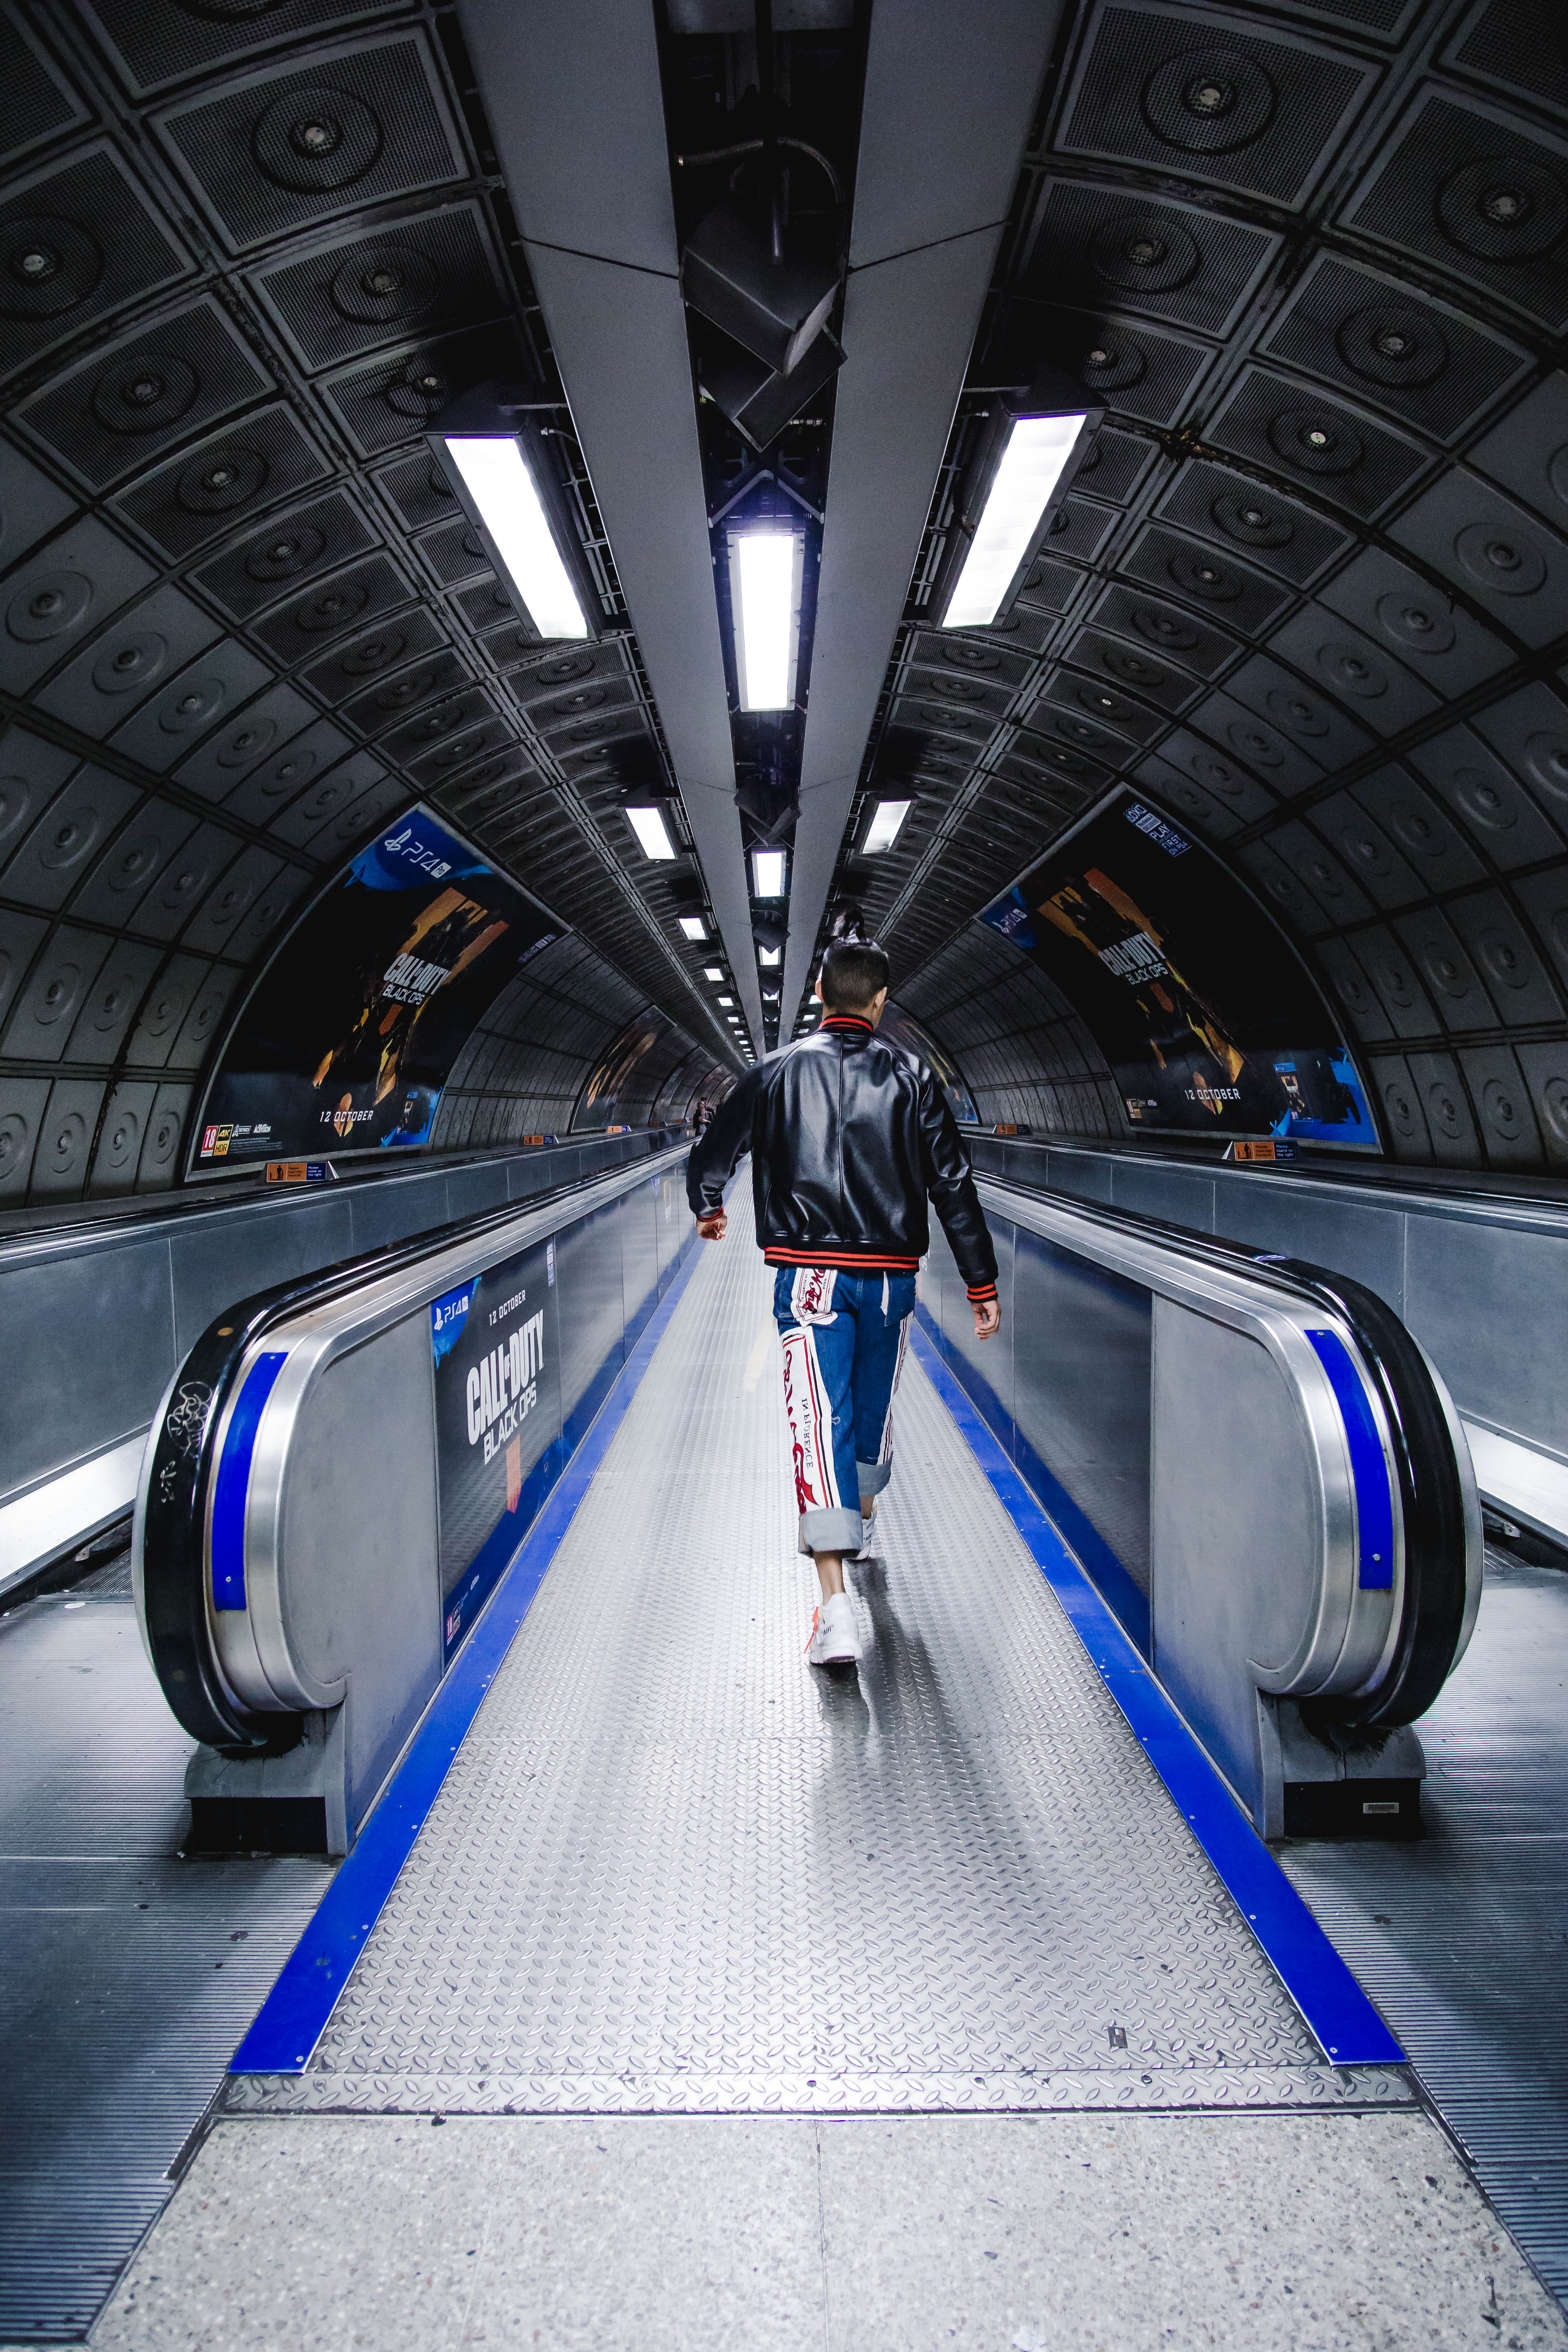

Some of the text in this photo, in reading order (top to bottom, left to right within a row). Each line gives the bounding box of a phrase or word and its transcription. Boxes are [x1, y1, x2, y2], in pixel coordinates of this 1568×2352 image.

[1149, 824, 1170, 841] PLAY
[1162, 834, 1181, 848] FIRST
[402, 842, 440, 871] PS4
[1098, 944, 1137, 976] CALL
[1120, 931, 1166, 967] DUTY
[383, 953, 425, 987] CALL
[410, 963, 451, 995] DUTY
[1125, 963, 1168, 985] BLACK OPS
[383, 984, 425, 1005] BLACK OPS
[1185, 1088, 1241, 1099] 12 OCTOBER
[320, 1110, 373, 1122] 12 OCTOBER
[204, 1129, 216, 1148] 18
[215, 1144, 228, 1152] HDR
[444, 1300, 462, 1323] PS4
[489, 1290, 526, 1326] 12 OCTOBER
[467, 1309, 543, 1445] CALL OF DUTY
[484, 1380, 536, 1465] BLACK OPS
